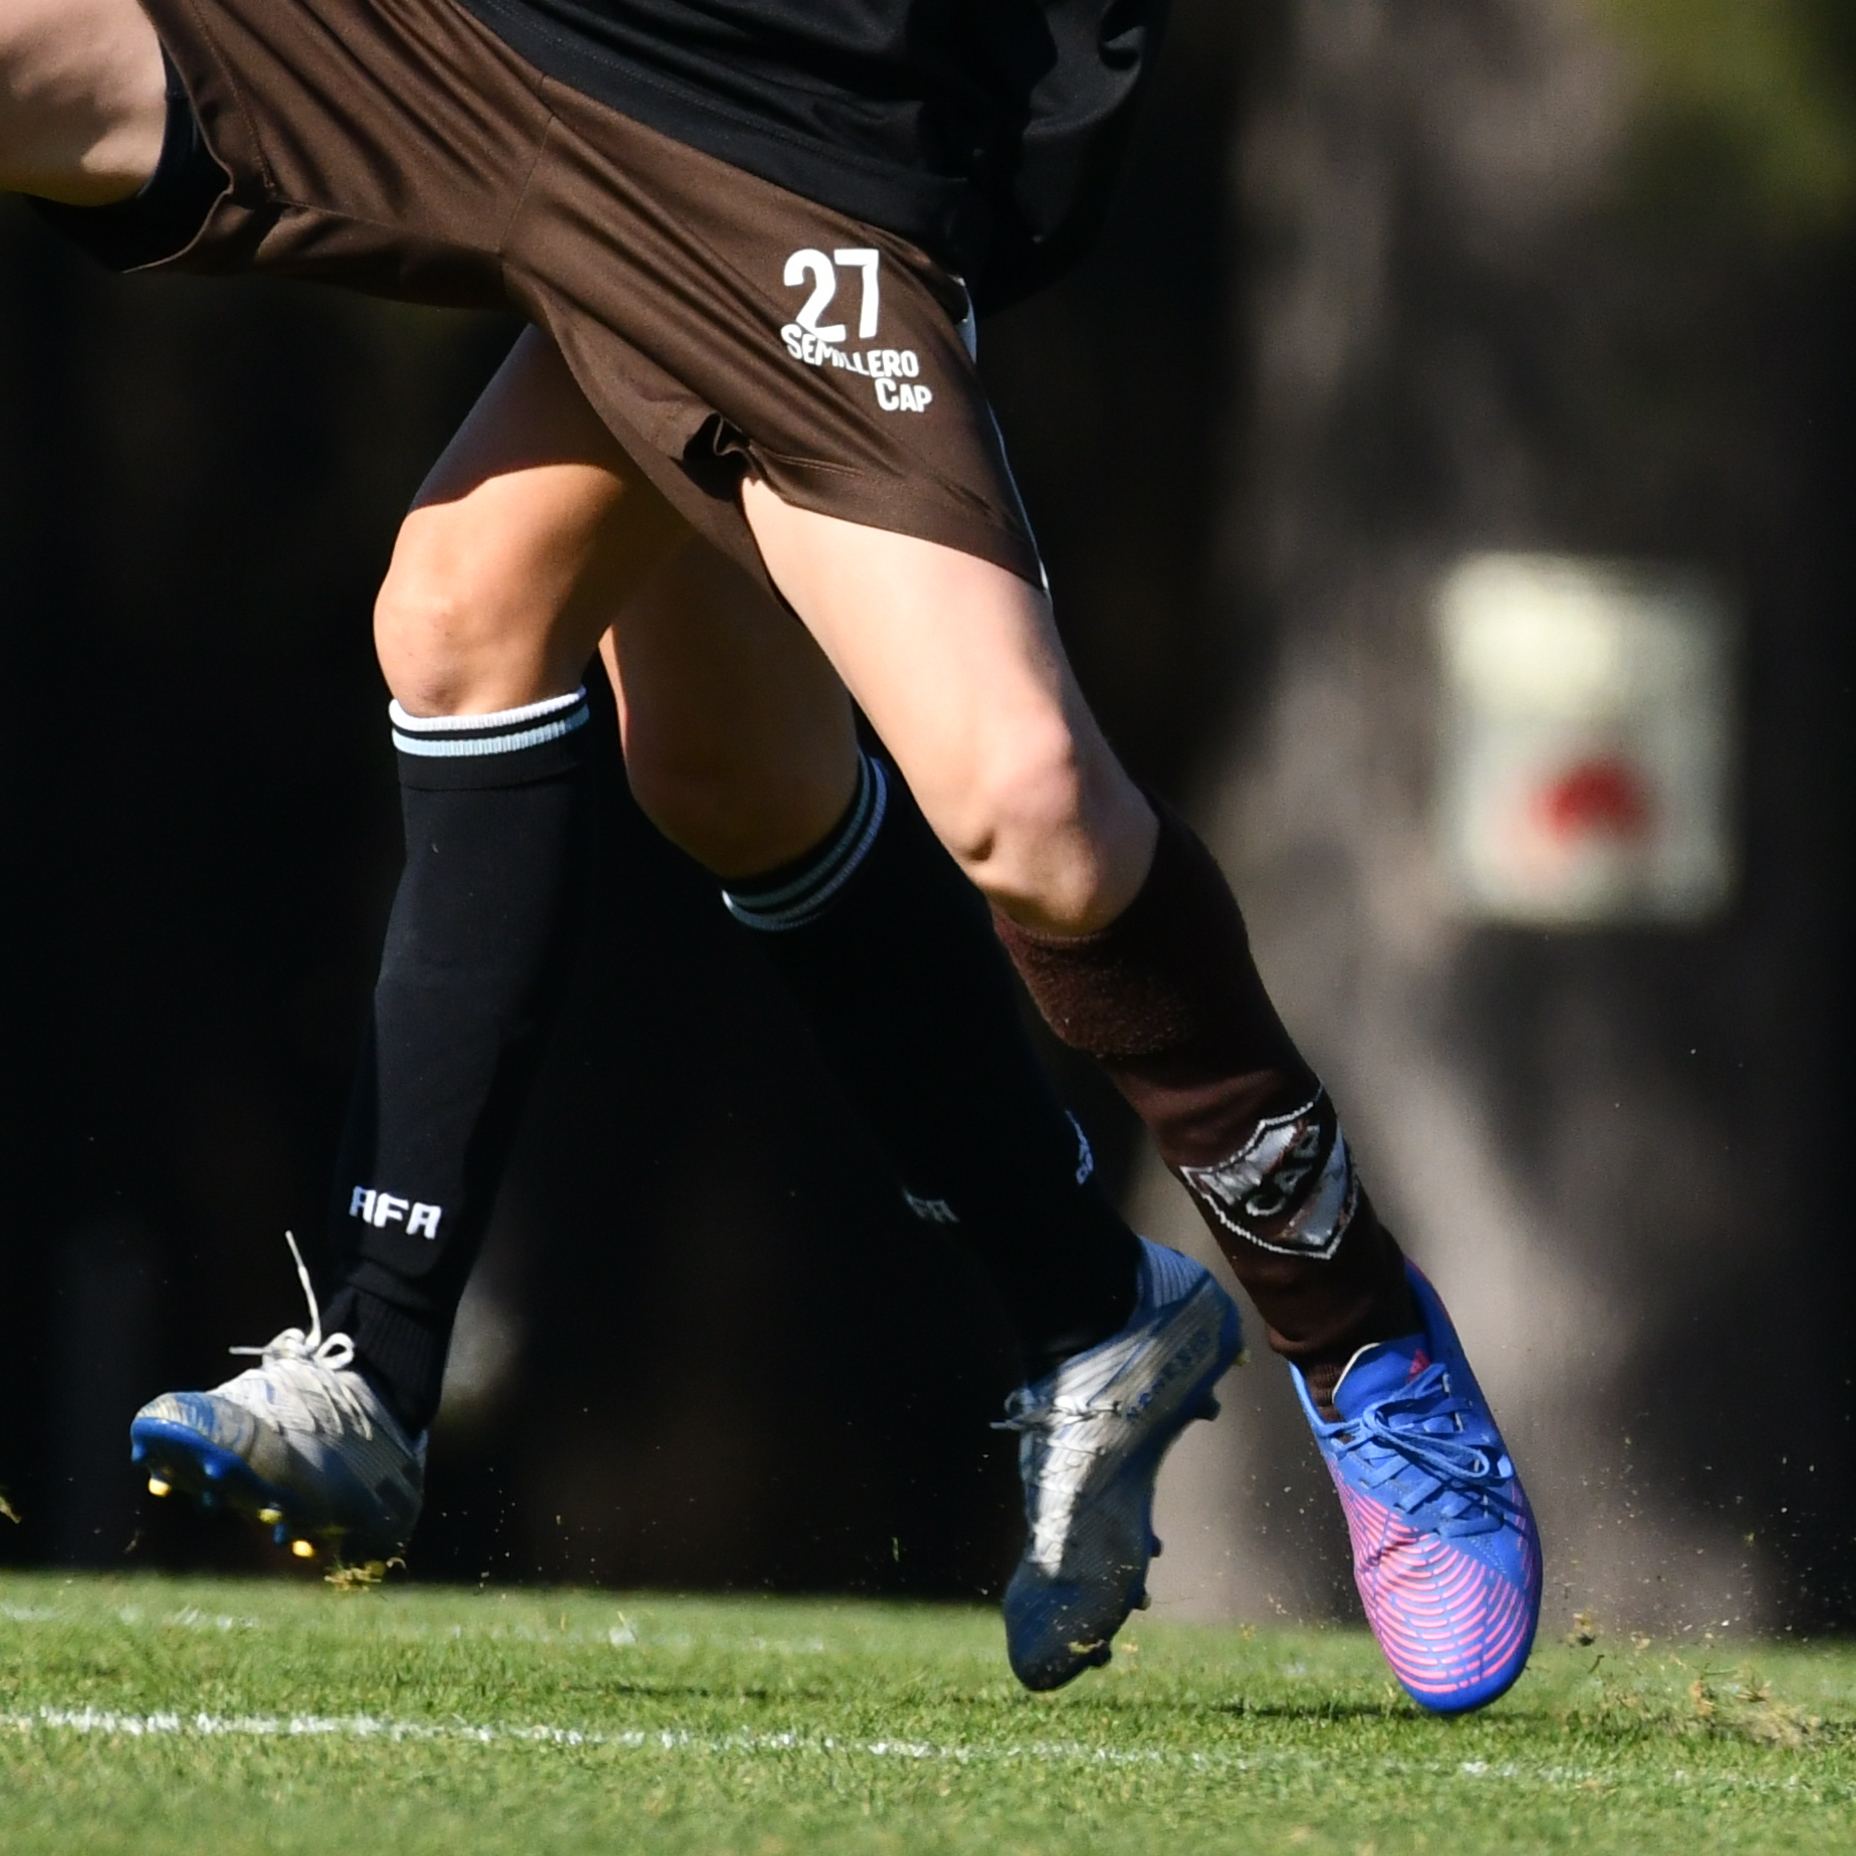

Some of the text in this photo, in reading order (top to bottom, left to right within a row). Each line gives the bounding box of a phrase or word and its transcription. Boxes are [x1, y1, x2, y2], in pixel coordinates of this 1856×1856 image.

[783, 248, 879, 342] 27
[781, 323, 919, 379] SEMILLERO
[875, 377, 933, 413] CAP
[348, 1185, 442, 1240] AFA
